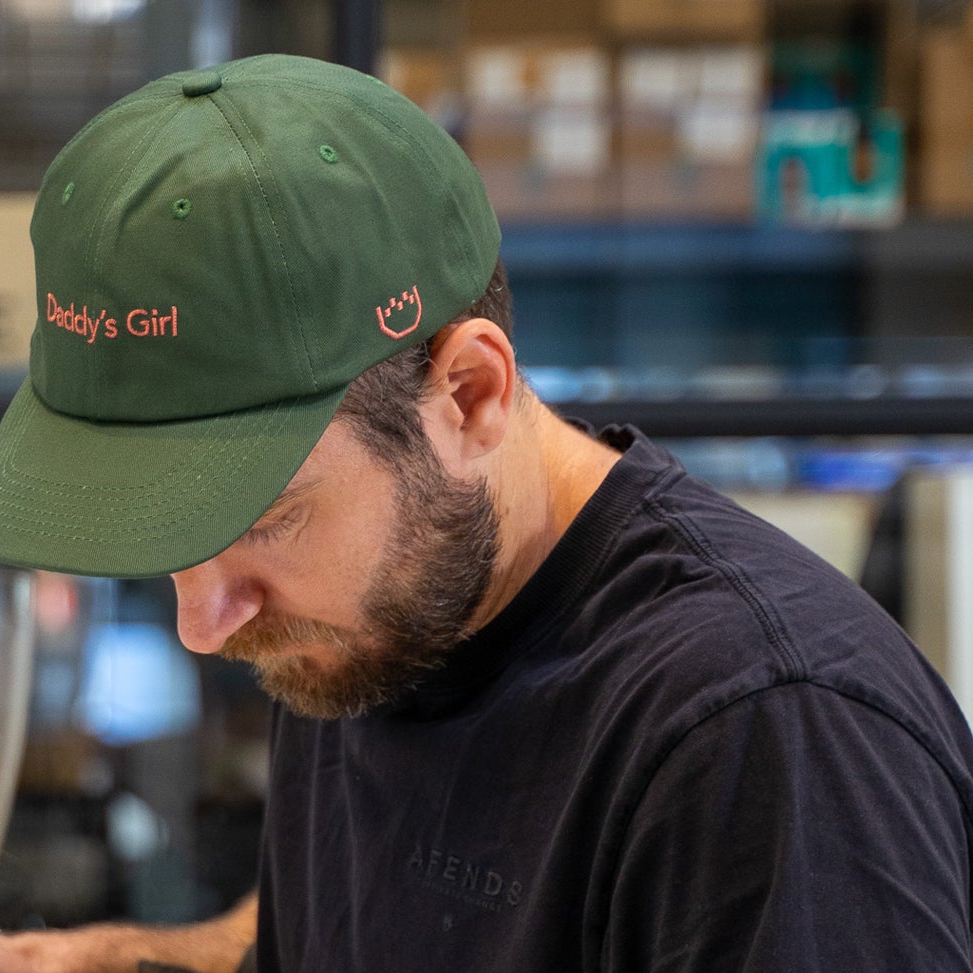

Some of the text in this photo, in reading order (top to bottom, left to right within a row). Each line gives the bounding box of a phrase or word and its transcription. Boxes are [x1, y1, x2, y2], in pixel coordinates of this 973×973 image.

[46, 292, 178, 344] Daddy's Girl
[408, 845, 523, 906] AFENDS
